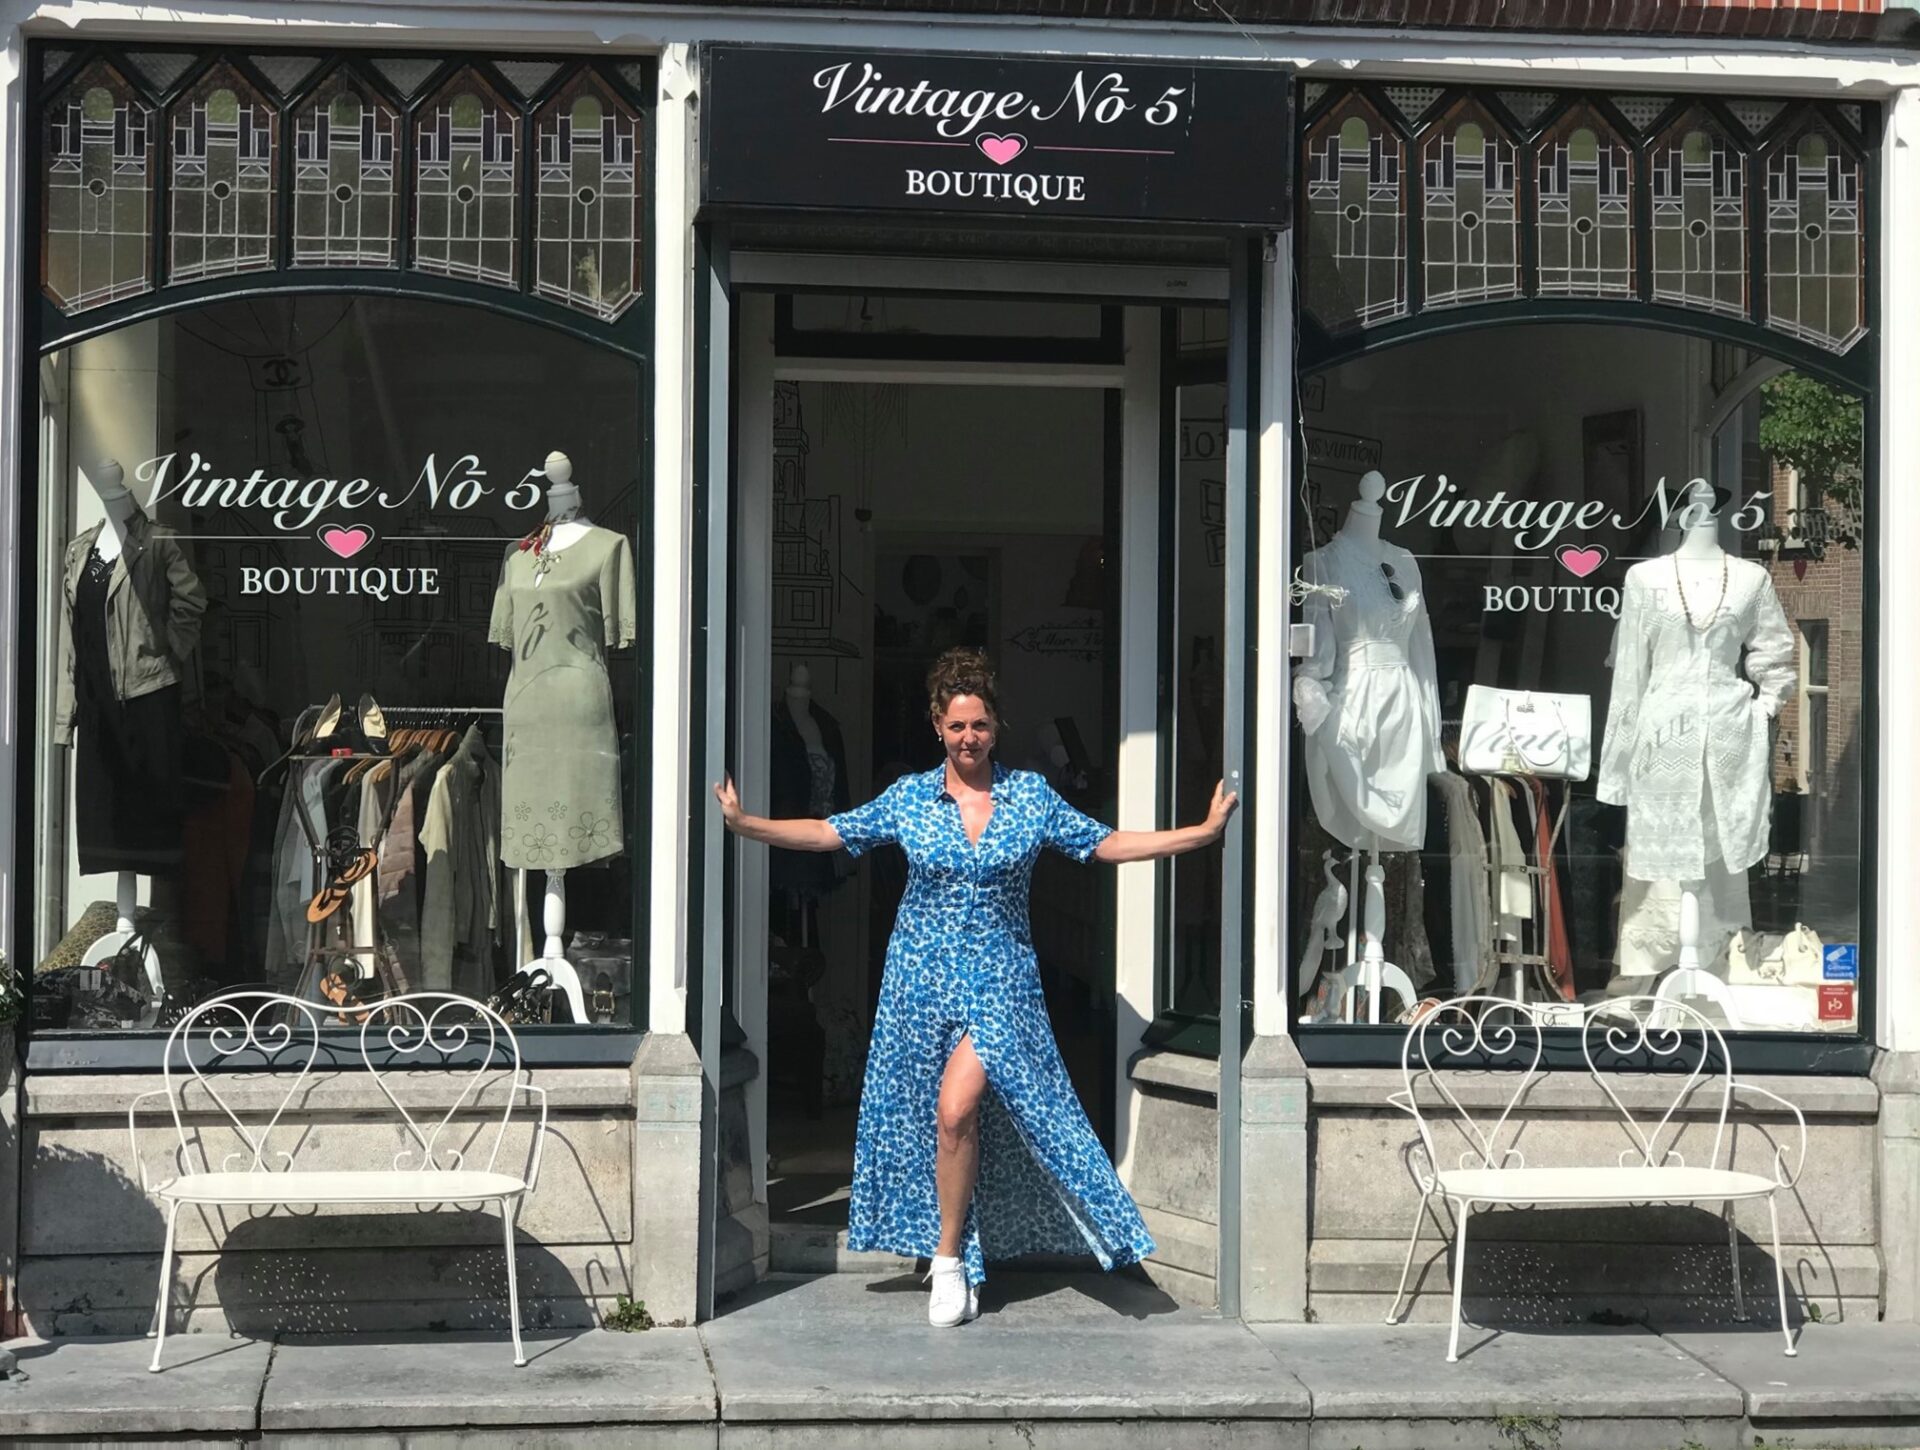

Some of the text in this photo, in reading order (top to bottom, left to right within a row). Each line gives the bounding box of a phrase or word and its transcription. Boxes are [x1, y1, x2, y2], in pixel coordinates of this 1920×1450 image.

[812, 61, 1033, 138] Vintage
[1144, 86, 1187, 126] 5
[904, 168, 1087, 206] BOUTIQUE
[134, 451, 380, 532] Vintage
[503, 467, 549, 511] 5
[1385, 473, 1615, 552] Vintage
[1730, 489, 1774, 532] 5
[239, 566, 441, 603] BOUTIQUE
